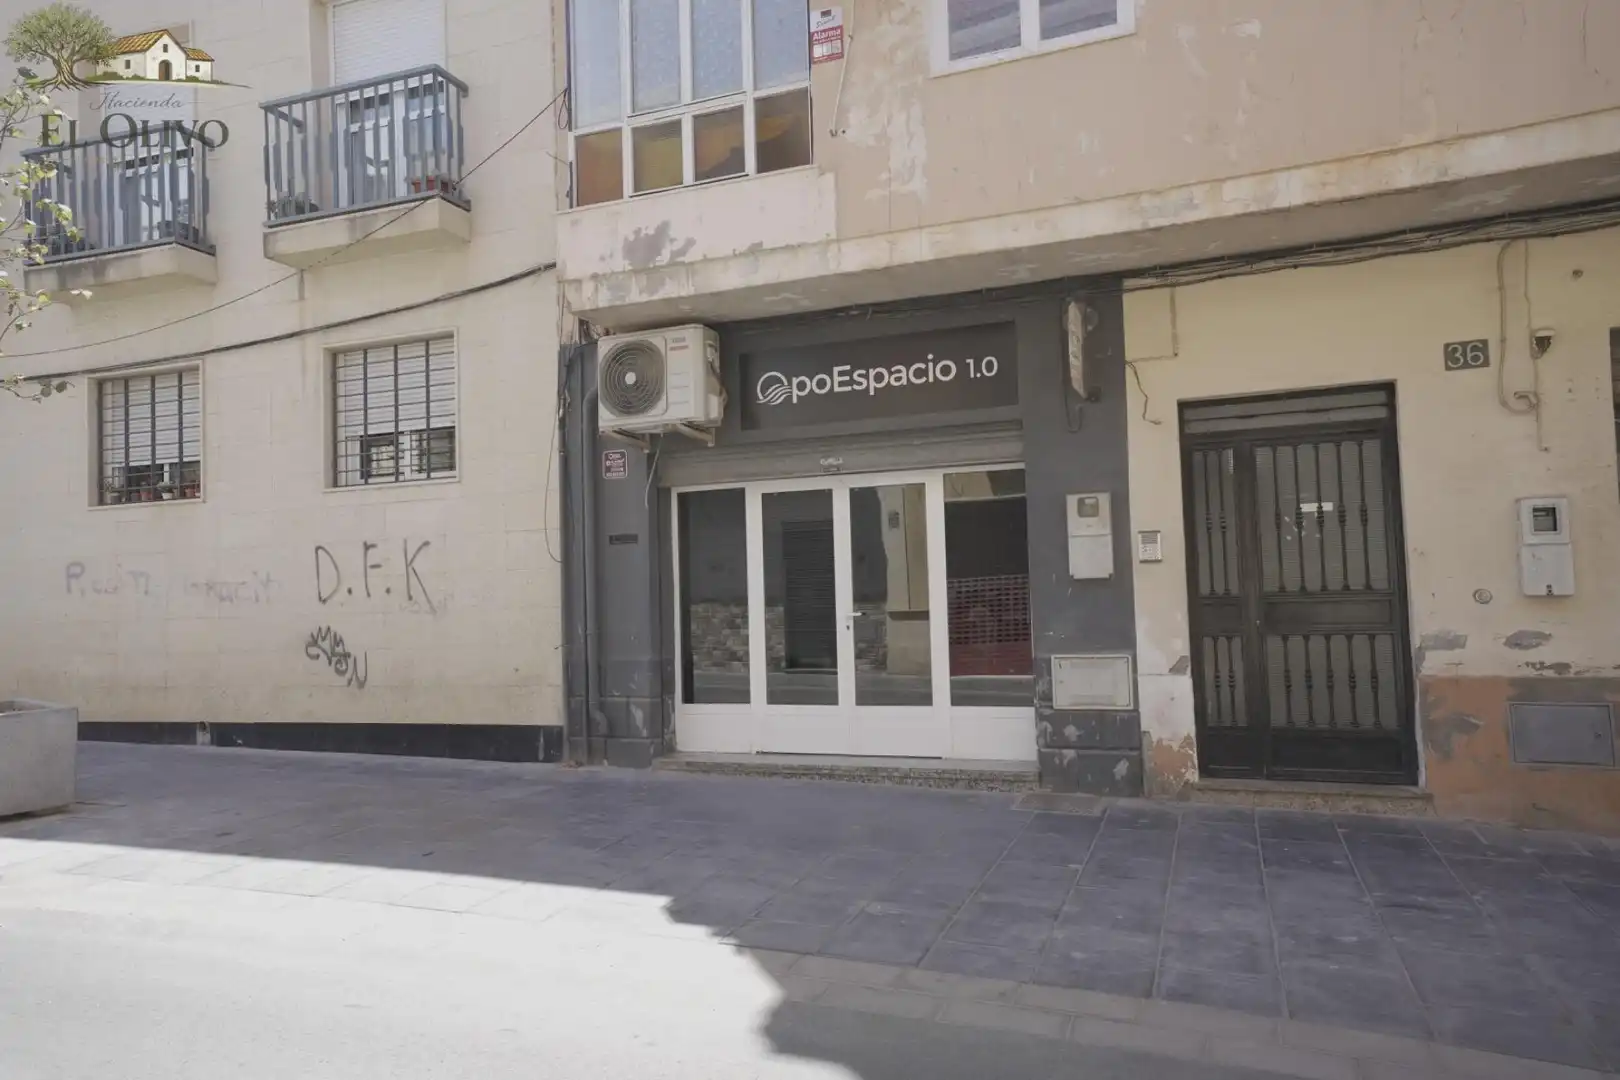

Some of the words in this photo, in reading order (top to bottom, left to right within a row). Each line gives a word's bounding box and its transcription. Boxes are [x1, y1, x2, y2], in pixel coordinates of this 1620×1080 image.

[812, 29, 841, 41] Alarma
[1447, 341, 1484, 368] 36
[965, 355, 999, 379] 1.0
